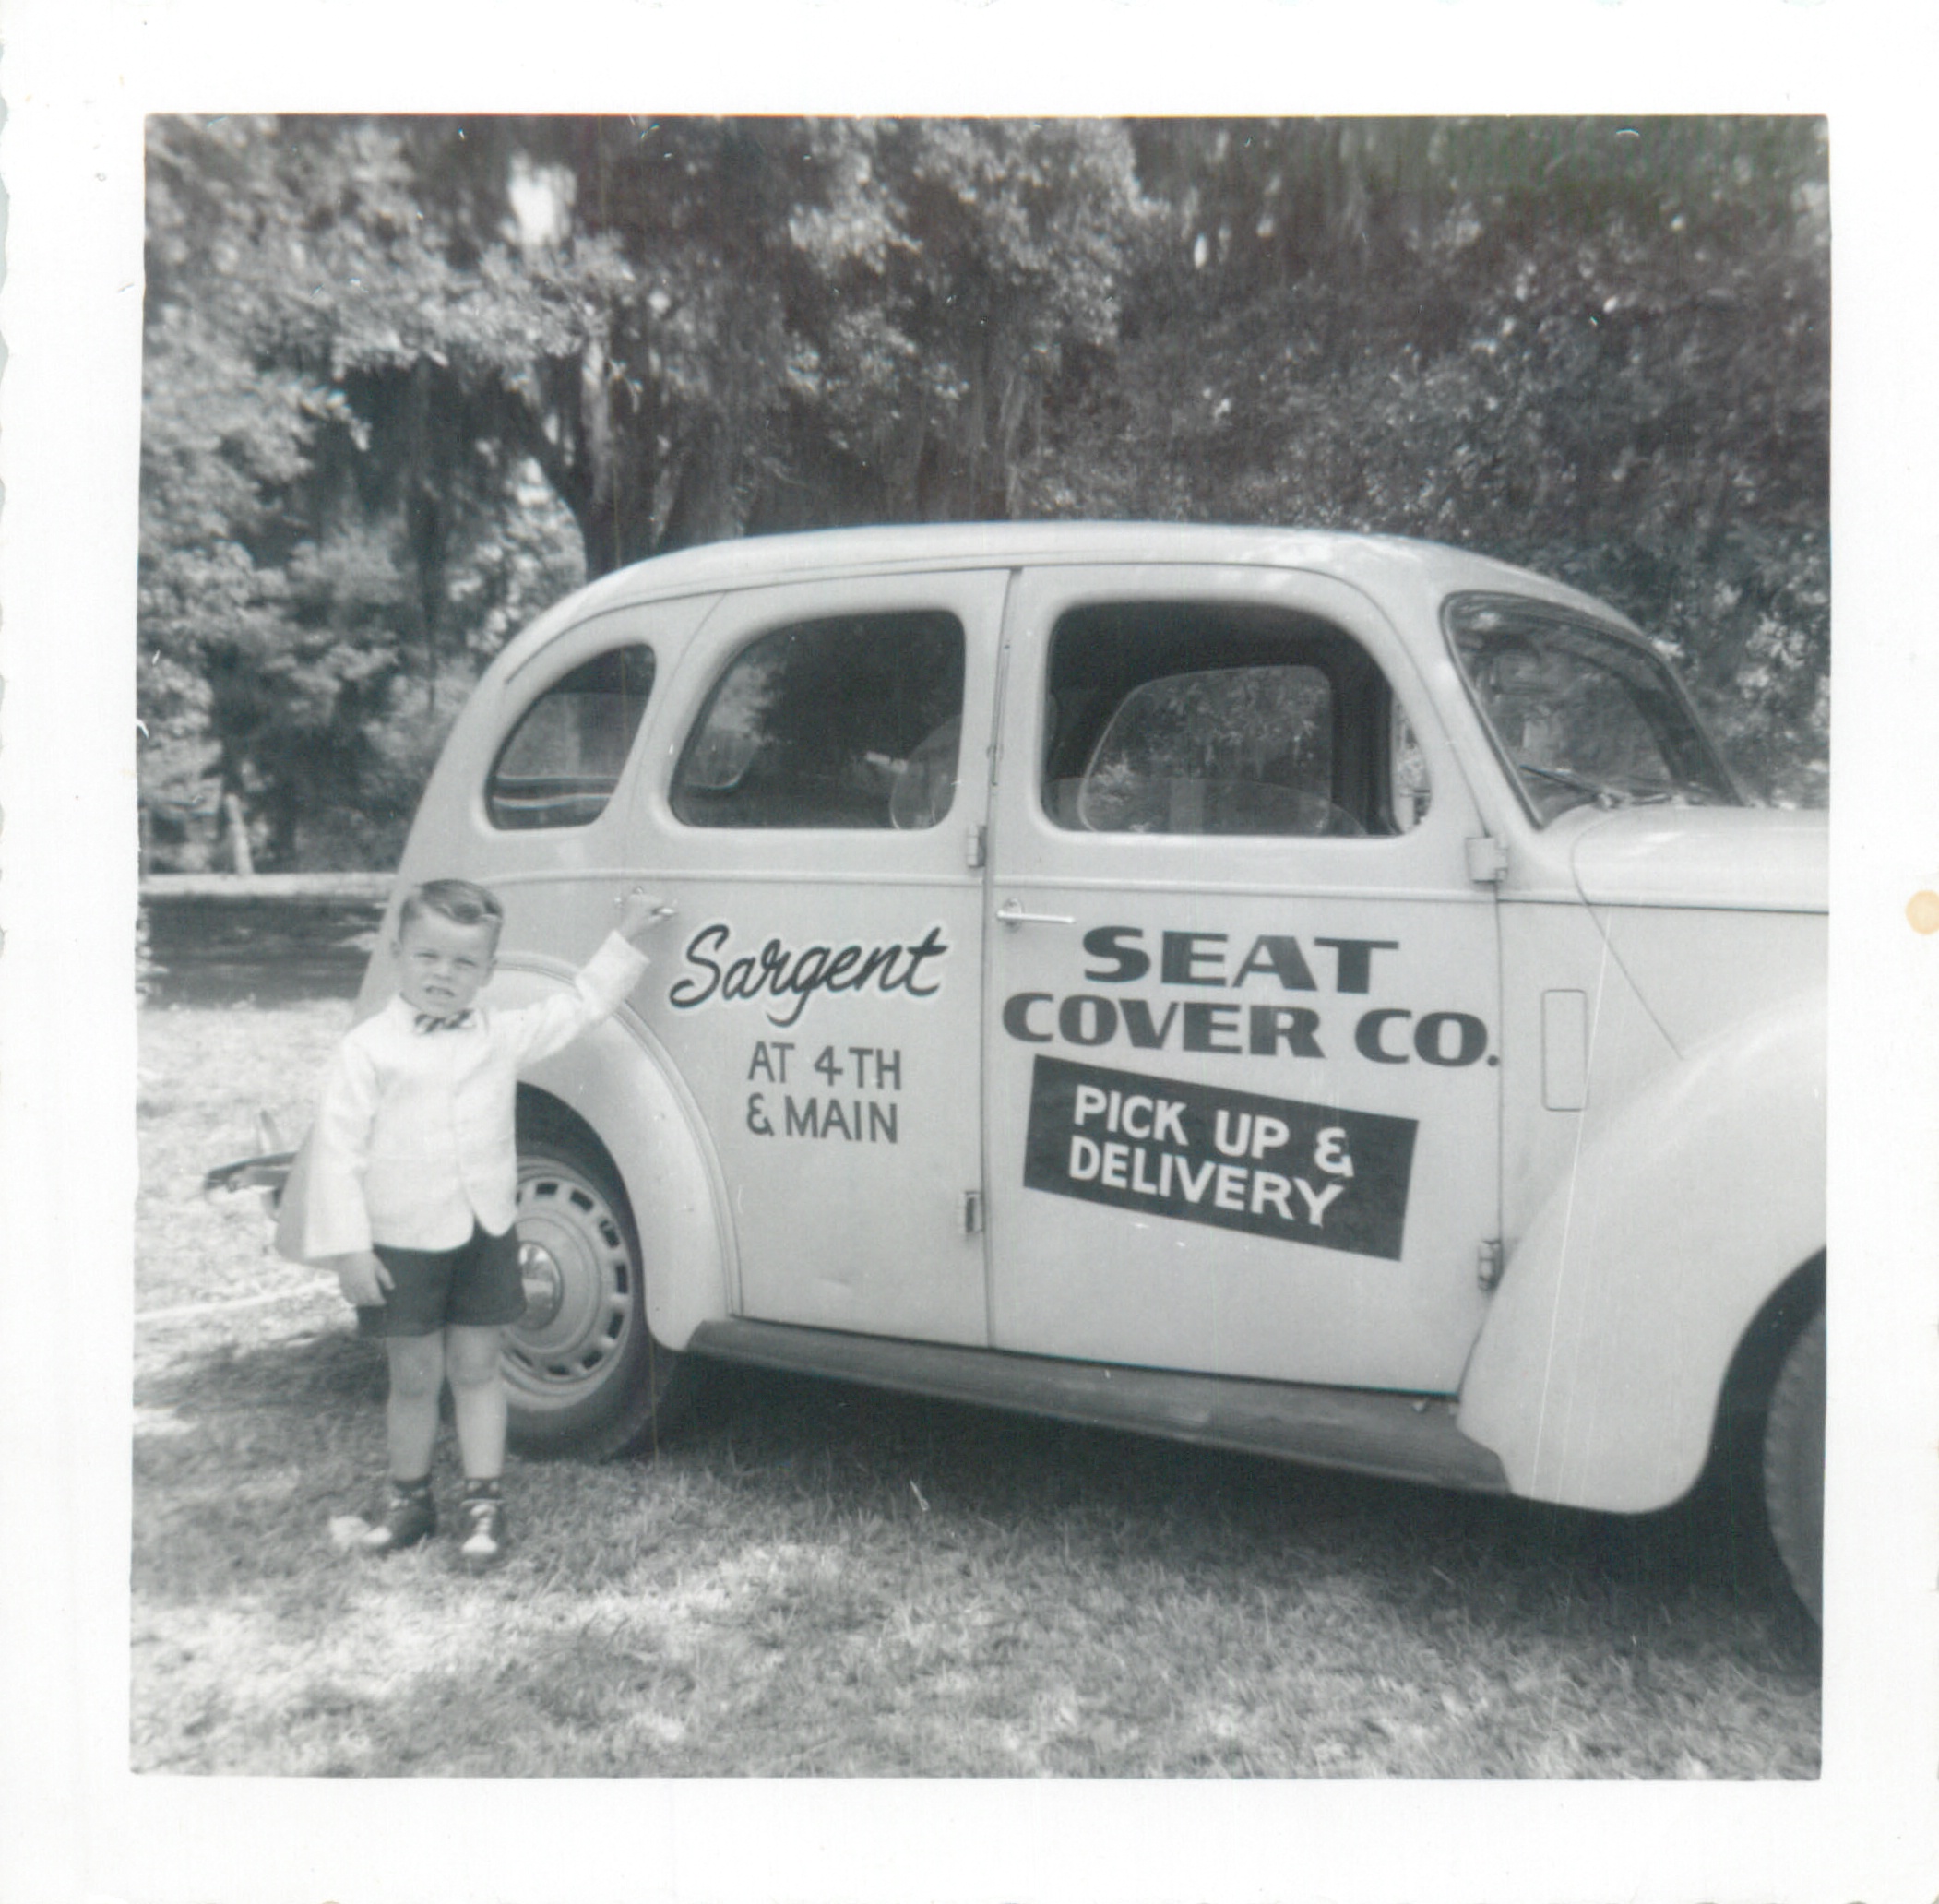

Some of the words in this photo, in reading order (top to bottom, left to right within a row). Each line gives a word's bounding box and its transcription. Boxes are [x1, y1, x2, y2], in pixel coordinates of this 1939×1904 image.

[669, 923, 949, 1028] Sargent
[1082, 925, 1399, 994] SEAT
[747, 1040, 795, 1084] AT
[1002, 992, 1326, 1059] COVER
[1354, 1008, 1500, 1067] CO.
[745, 1092, 775, 1137] &
[784, 1095, 898, 1144] MAIN
[1074, 1084, 1190, 1147] PICK
[1214, 1109, 1290, 1160] UP
[1314, 1126, 1355, 1179] &
[1067, 1134, 1345, 1229] DELIVERY
